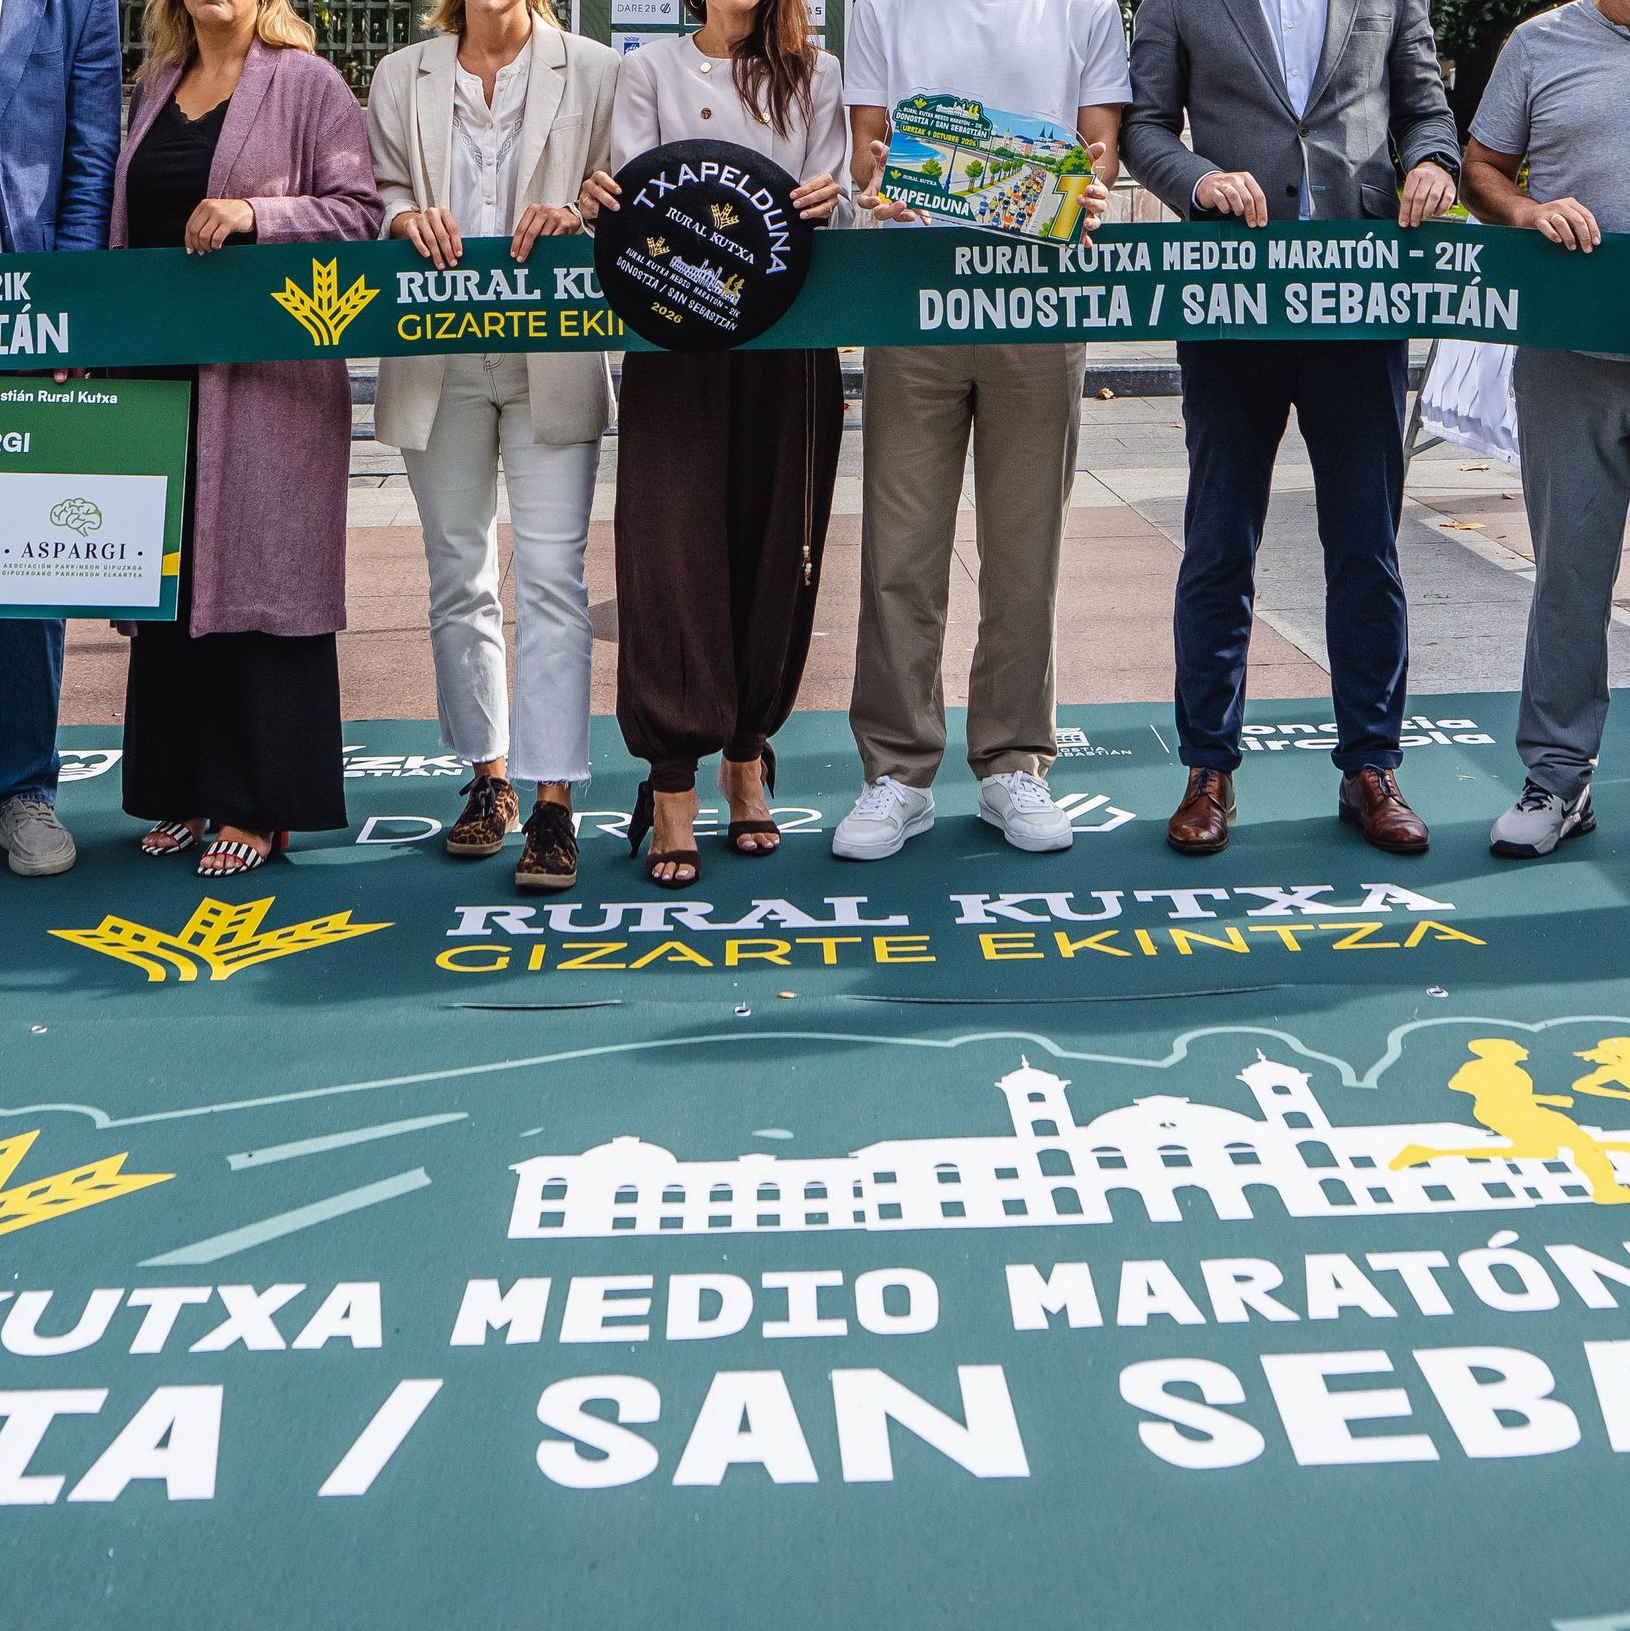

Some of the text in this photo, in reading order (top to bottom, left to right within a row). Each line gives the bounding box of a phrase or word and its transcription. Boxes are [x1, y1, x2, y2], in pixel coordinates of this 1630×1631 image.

[896, 111, 929, 125] DONOSTIA
[935, 120, 949, 130] SAN
[950, 123, 988, 139] SEBASTIÁN
[902, 124, 925, 136] URRIAK
[932, 131, 960, 143] OCTUBRE
[632, 161, 791, 275] TXAPELDUNA
[885, 184, 970, 217] TXAPELDUNA
[665, 206, 754, 265] RURAL KUTXA
[954, 244, 1050, 275] RURAL
[1057, 241, 1153, 274] KUTXA
[1163, 240, 1257, 272] MEDIO
[1267, 232, 1400, 270] MARATÓN
[1434, 241, 1484, 274] 21K
[395, 267, 542, 304] RURAL
[625, 247, 645, 265] RURAL
[646, 259, 670, 278] KUTXA
[669, 269, 691, 289] MEDIO
[616, 255, 659, 290] DONOSTIA
[667, 286, 689, 306] SAN
[688, 298, 740, 332] SEBASTIÁN
[650, 300, 684, 325] 2026
[918, 274, 1520, 332] DONOSTIA / SAN SEBASTIÁN
[396, 309, 549, 342] GIZARTE
[37, 389, 75, 403] Rural
[77, 390, 119, 404] Kutxa
[3, 562, 52, 570] ASOCIACIÓN
[54, 563, 101, 571] PARKINSON
[21, 541, 127, 560] ASPARGI
[445, 882, 1458, 938] RURAL KUTXA
[433, 918, 1487, 974] GIZARTE EKINTZA
[449, 1266, 941, 1348] MEDIO
[316, 1377, 435, 1498] /
[534, 1362, 1032, 1490] SAN
